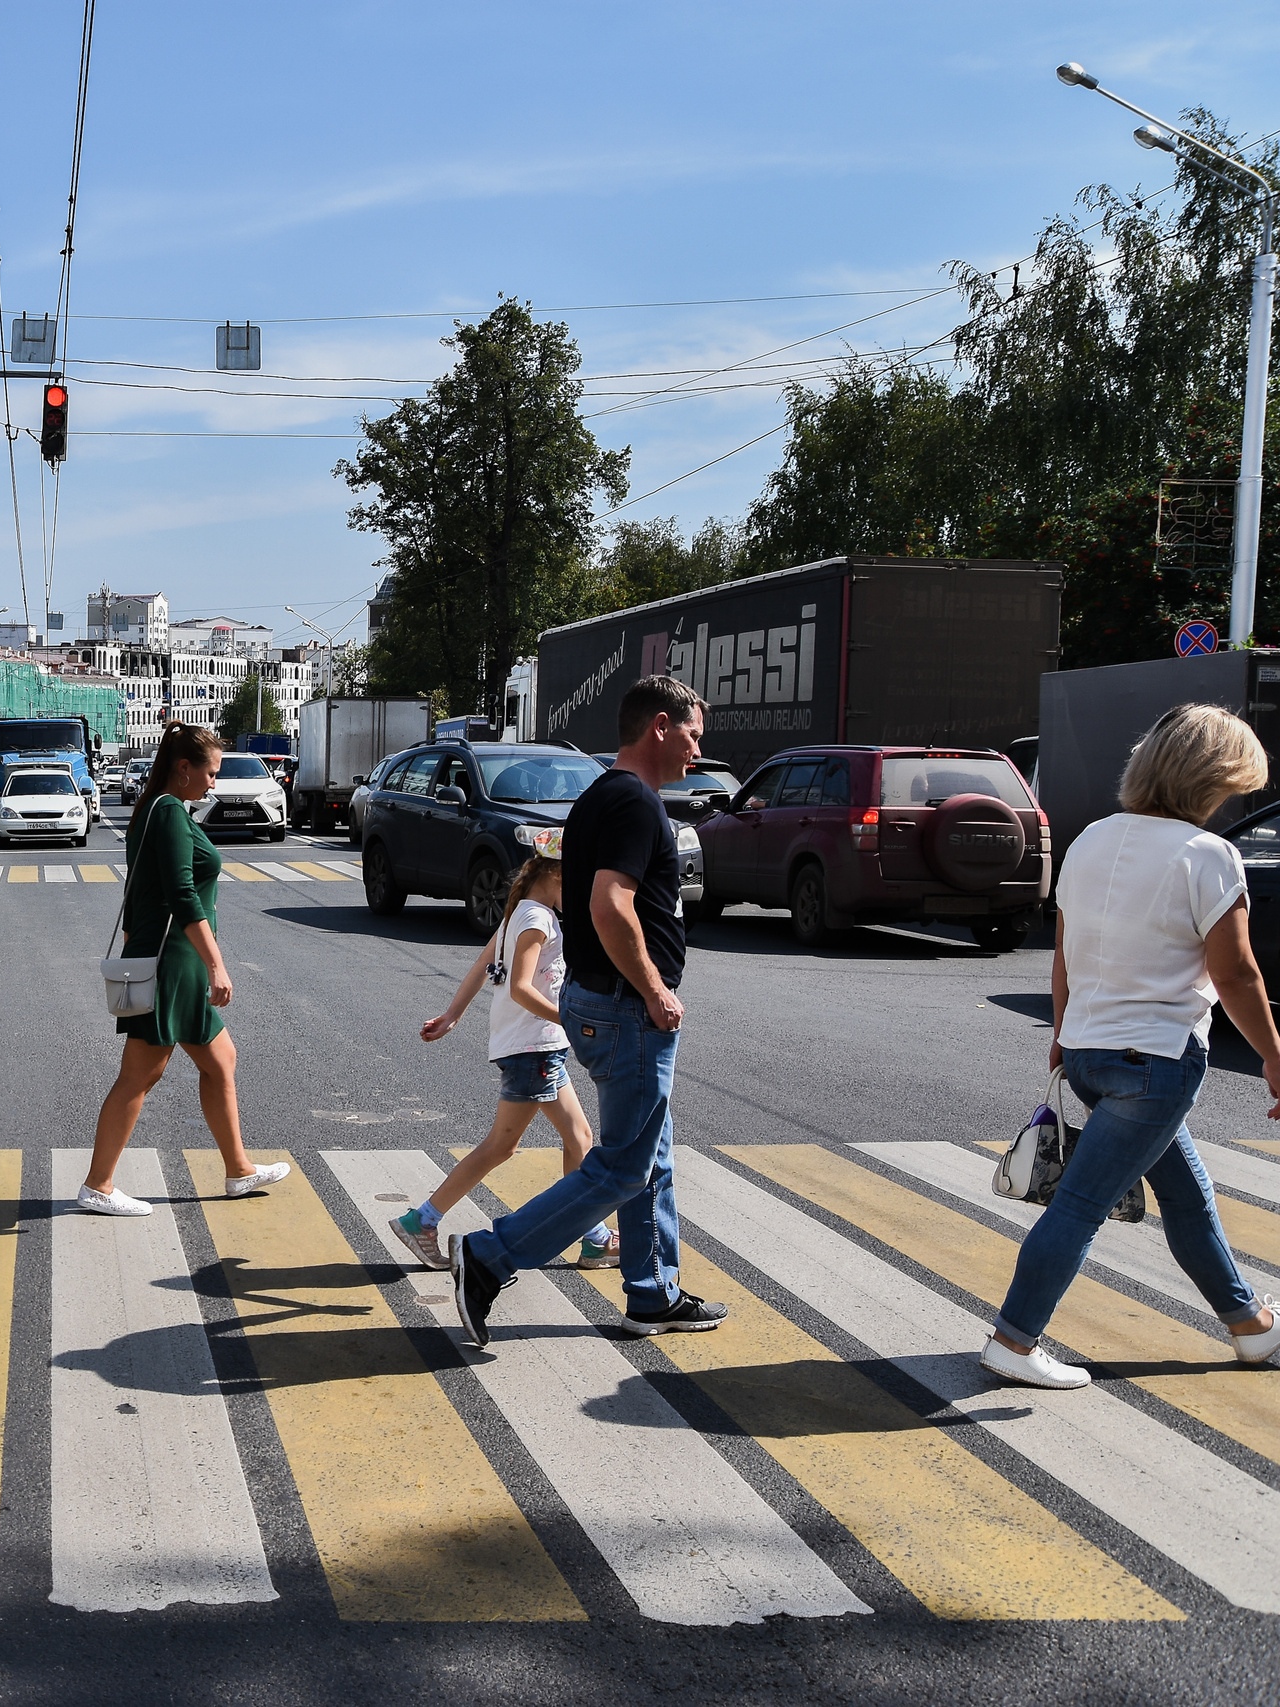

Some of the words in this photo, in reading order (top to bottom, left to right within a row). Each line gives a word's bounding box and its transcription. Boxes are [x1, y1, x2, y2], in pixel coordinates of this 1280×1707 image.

[547, 630, 627, 739] ferry-very-good
[714, 709, 772, 731] DEUTSCHLAND
[773, 708, 812, 731] IRELAND
[948, 834, 1018, 848] SUZUKI
